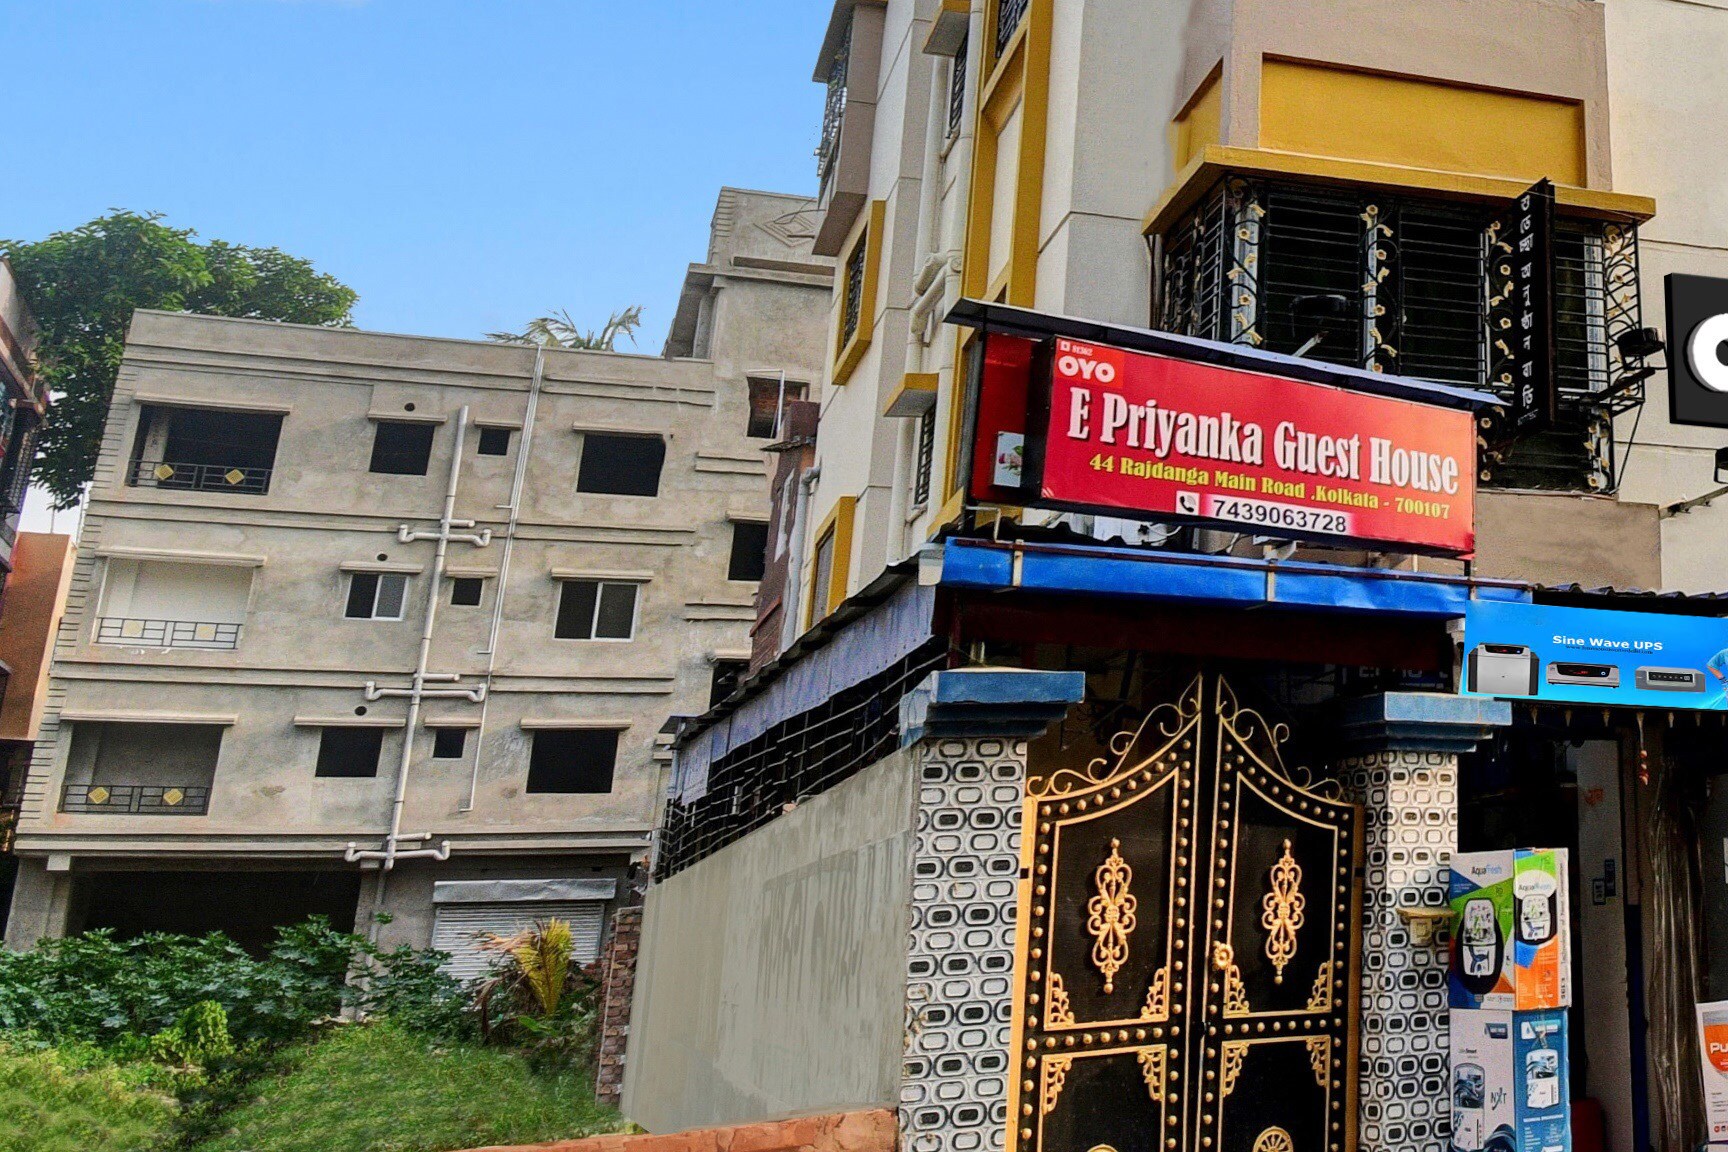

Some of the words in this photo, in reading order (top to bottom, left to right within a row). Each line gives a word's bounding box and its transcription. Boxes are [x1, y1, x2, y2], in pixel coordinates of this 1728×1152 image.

[1058, 355, 1115, 383] OYO
[1067, 387, 1091, 440] E
[1100, 392, 1264, 465] Priyanka
[1273, 421, 1360, 480] Guest
[1369, 436, 1459, 494] House
[1089, 453, 1114, 472] 44
[1120, 457, 1209, 485] Rajdanga
[1215, 470, 1256, 491] Main
[1261, 477, 1305, 498] Road
[1395, 497, 1450, 519] 700107
[1213, 499, 1347, 533] 7439063728
[1552, 635, 1584, 645] Sine
[1589, 637, 1629, 649] Wave
[1634, 640, 1663, 651] UPS
